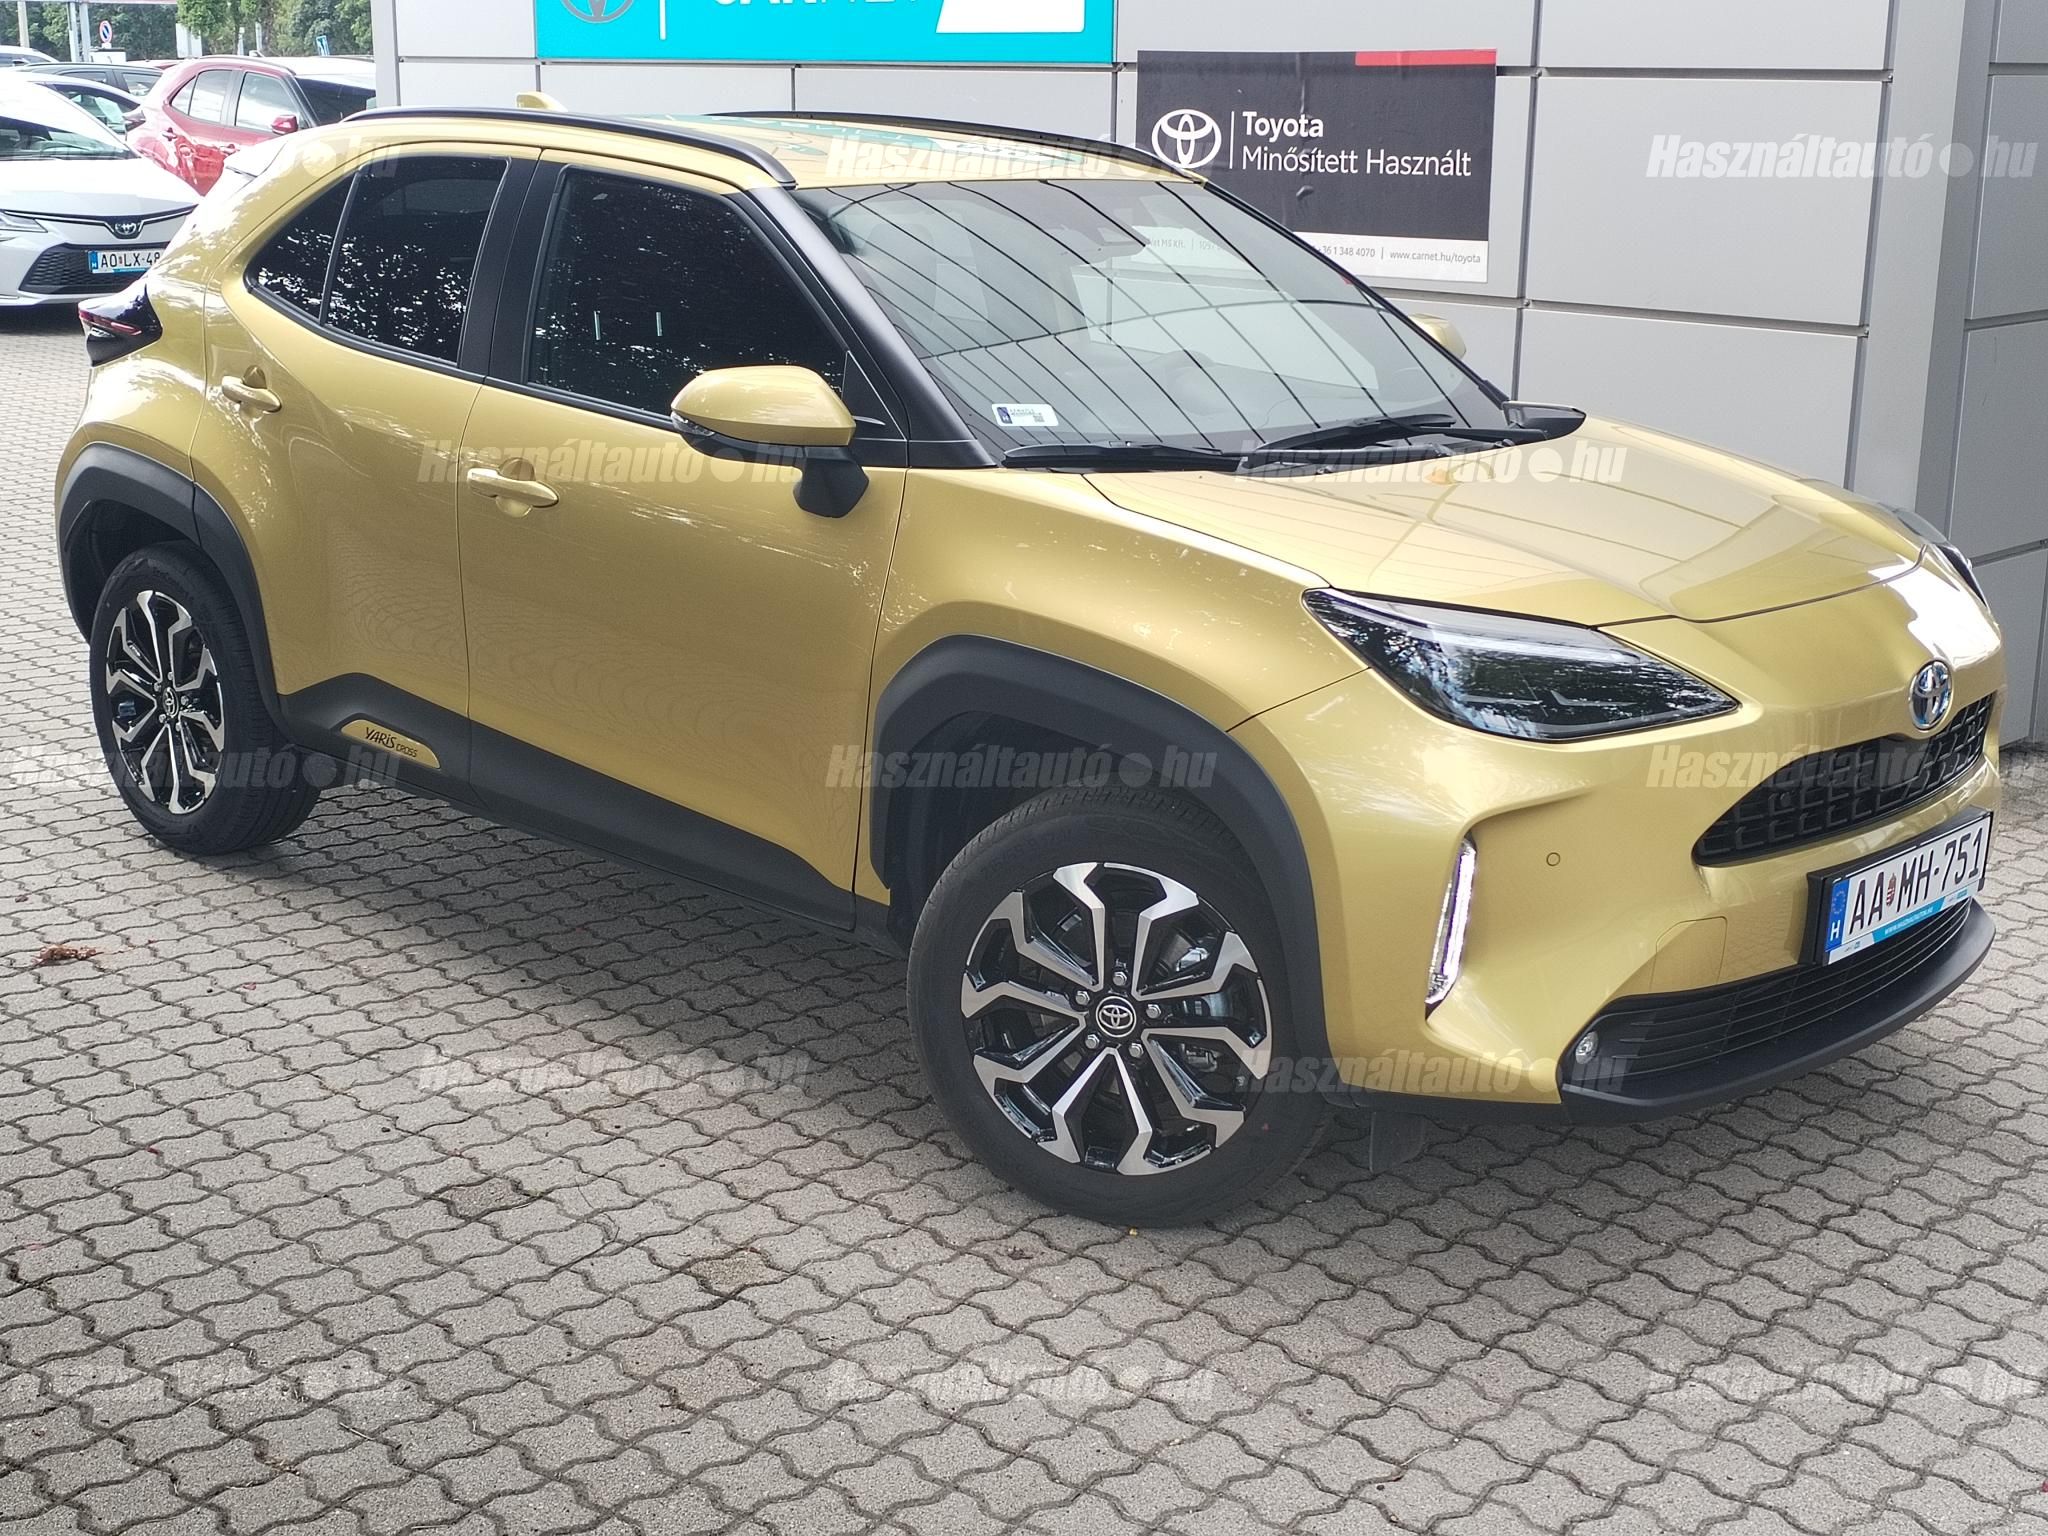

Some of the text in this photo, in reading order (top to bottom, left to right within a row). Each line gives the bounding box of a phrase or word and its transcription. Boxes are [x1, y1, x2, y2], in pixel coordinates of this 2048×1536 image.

[1242, 112, 1324, 143] Toyota
[1242, 146, 1472, 177] Minősített Használt
[101, 253, 118, 268] AO
[1340, 246, 1354, 256] 348
[1356, 248, 1376, 257] 4070
[1390, 251, 1481, 265] www.carnet.hu/toyota
[1849, 871, 1885, 935] AA
[1895, 827, 1983, 913] MH-751
[1829, 919, 1841, 941] H
